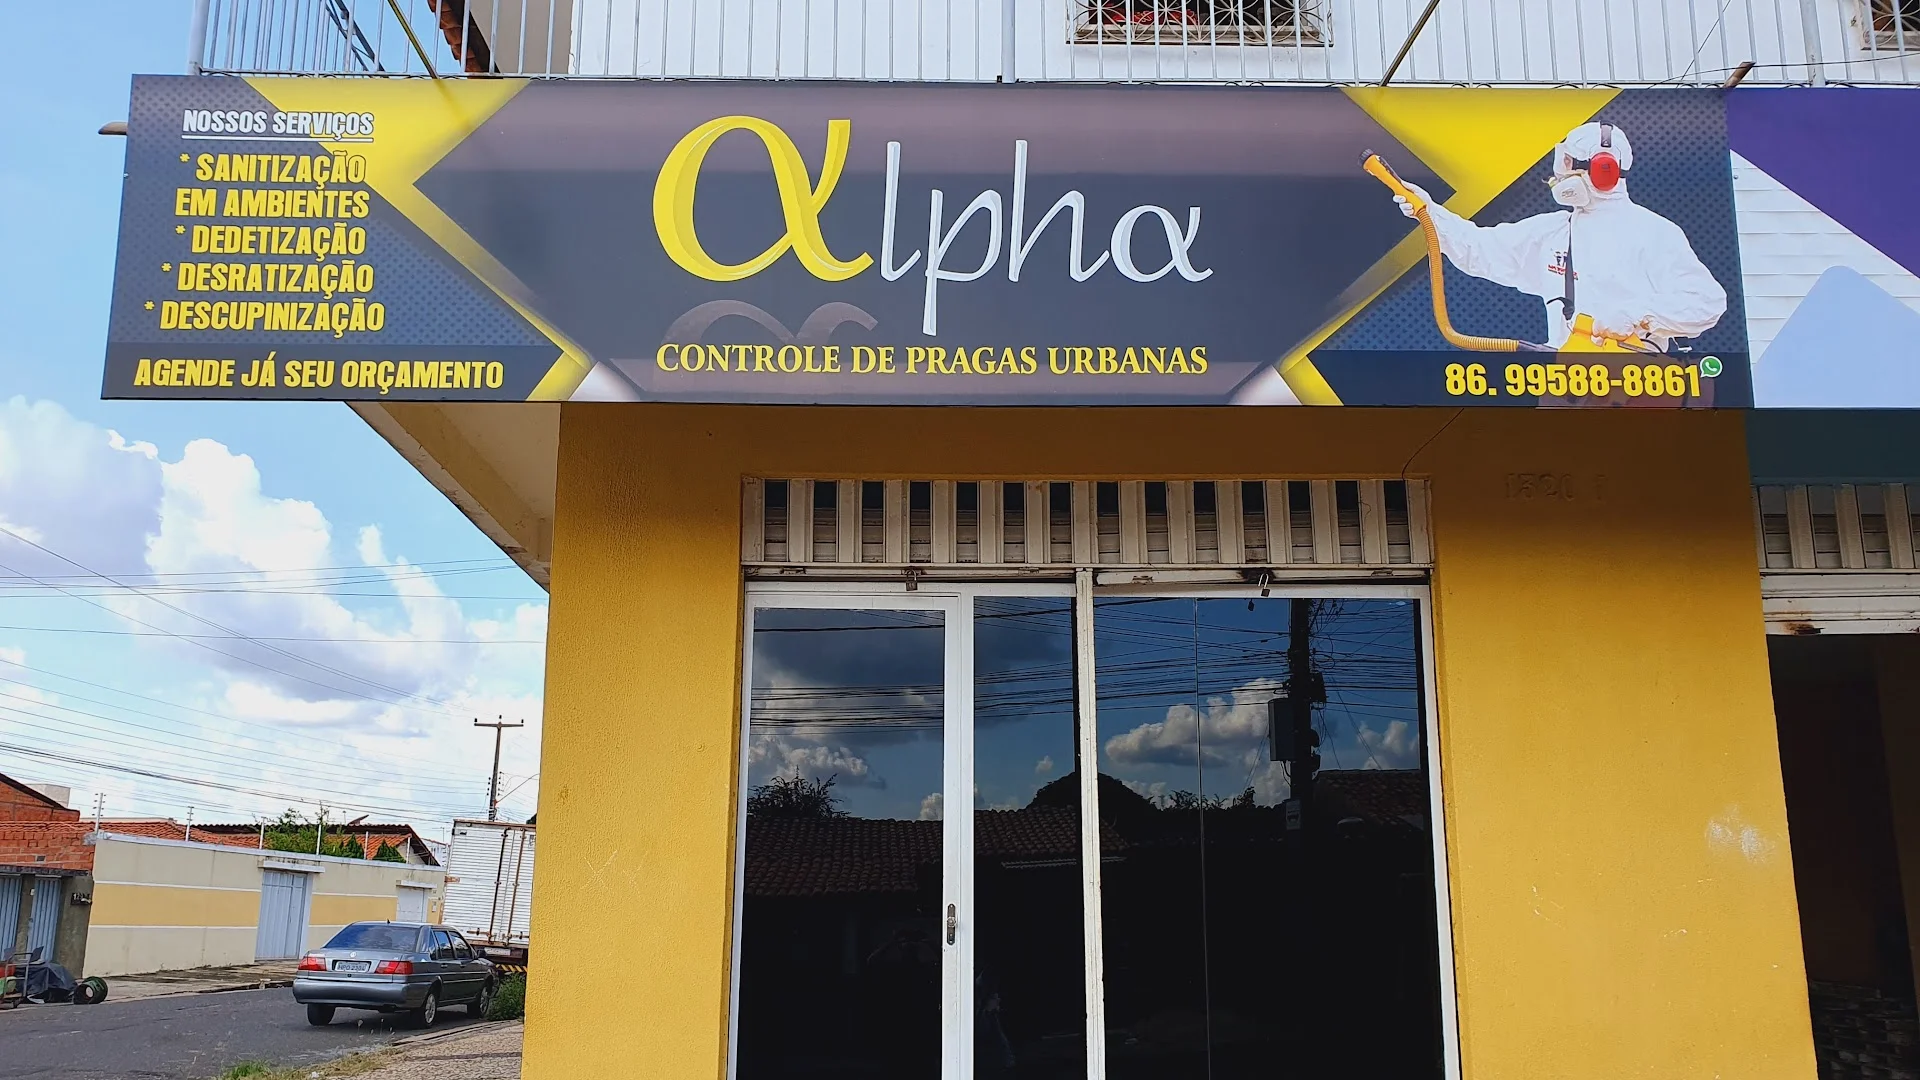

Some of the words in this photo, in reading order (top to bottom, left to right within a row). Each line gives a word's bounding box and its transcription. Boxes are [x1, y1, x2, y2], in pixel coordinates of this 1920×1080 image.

[182, 109, 267, 134] NOSSOS
[272, 112, 375, 142] SERVIÇOS
[195, 150, 367, 190] SANITIZAÇÃO
[175, 187, 217, 218] EM
[223, 188, 370, 219] AMBIENTES
[191, 222, 367, 262] DEDETIZAÇÃO
[177, 259, 374, 300] DESRATIZAÇÃO
[160, 299, 385, 338] DESCUPINIZAÇÃO
[133, 358, 235, 388] AGENDE
[241, 351, 276, 388] JÁ
[284, 360, 335, 388] SEU
[341, 360, 504, 394] ORÇAMENTO
[657, 343, 840, 374] CONTROLE
[851, 346, 895, 374] DE
[906, 346, 1038, 375] PRAGAS
[1048, 346, 1208, 375] URBANAS
[1444, 363, 1498, 396] 86.
[1504, 363, 1701, 397] 99588-8861
